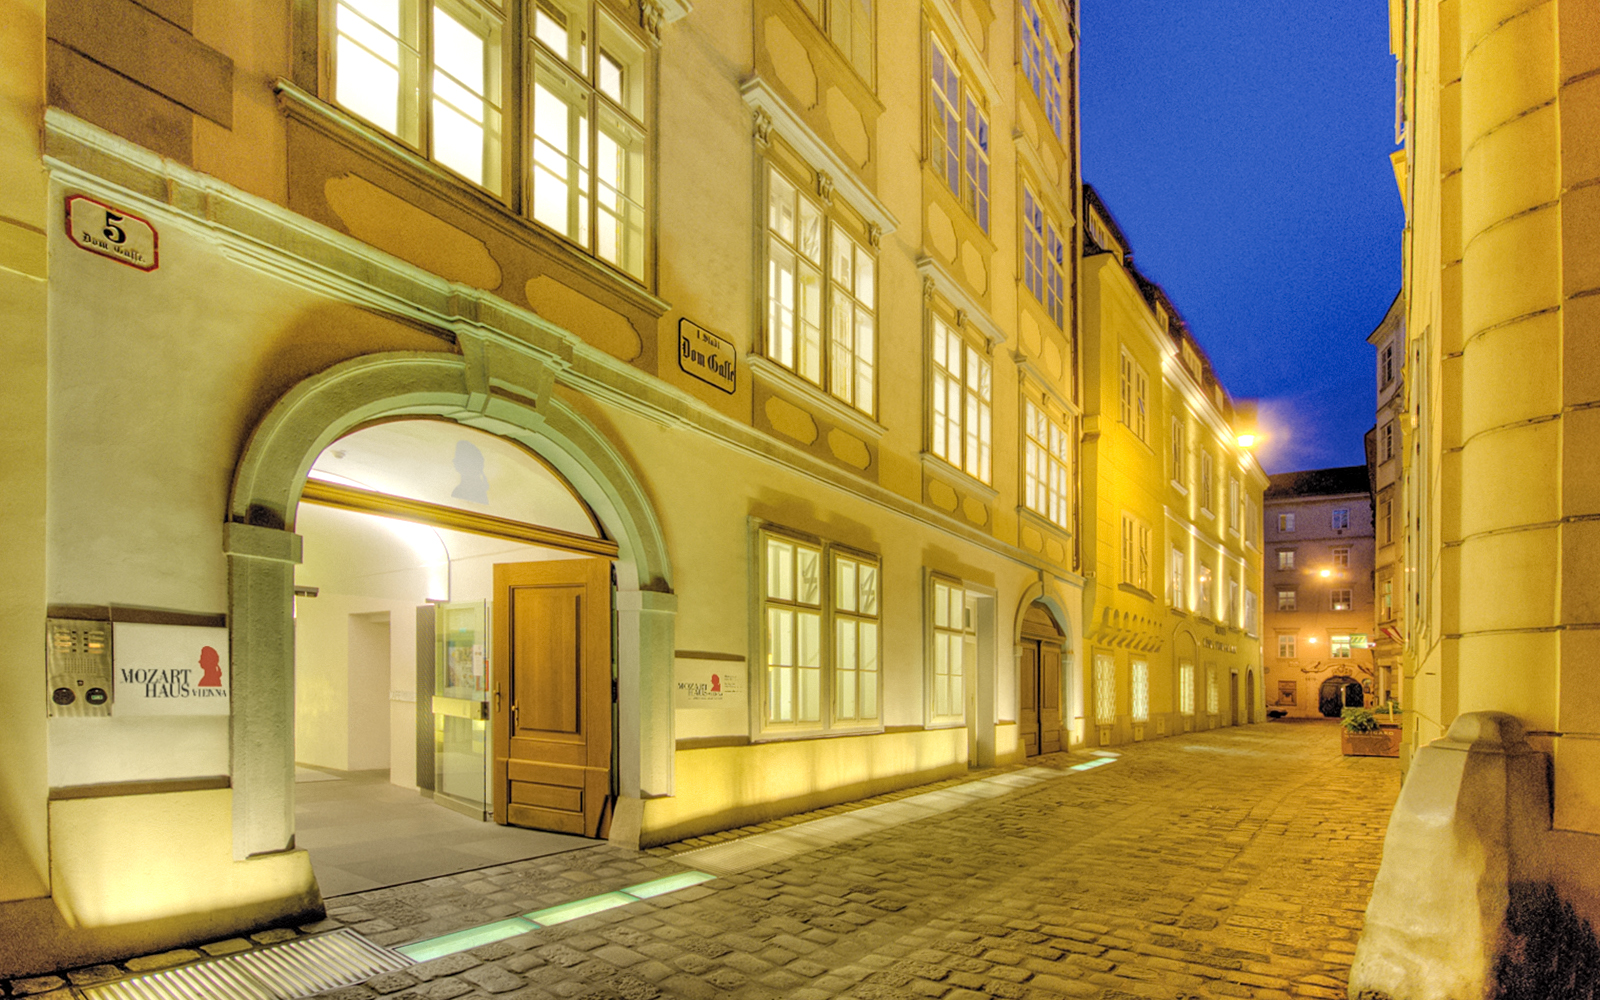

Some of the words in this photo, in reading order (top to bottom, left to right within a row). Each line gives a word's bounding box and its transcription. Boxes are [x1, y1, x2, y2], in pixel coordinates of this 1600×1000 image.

[103, 211, 126, 244] 5
[82, 231, 109, 250] Dom
[682, 335, 706, 368] Dom
[120, 668, 192, 685] MOZART
[144, 682, 190, 698] HAUS
[191, 688, 228, 698] VIENNA
